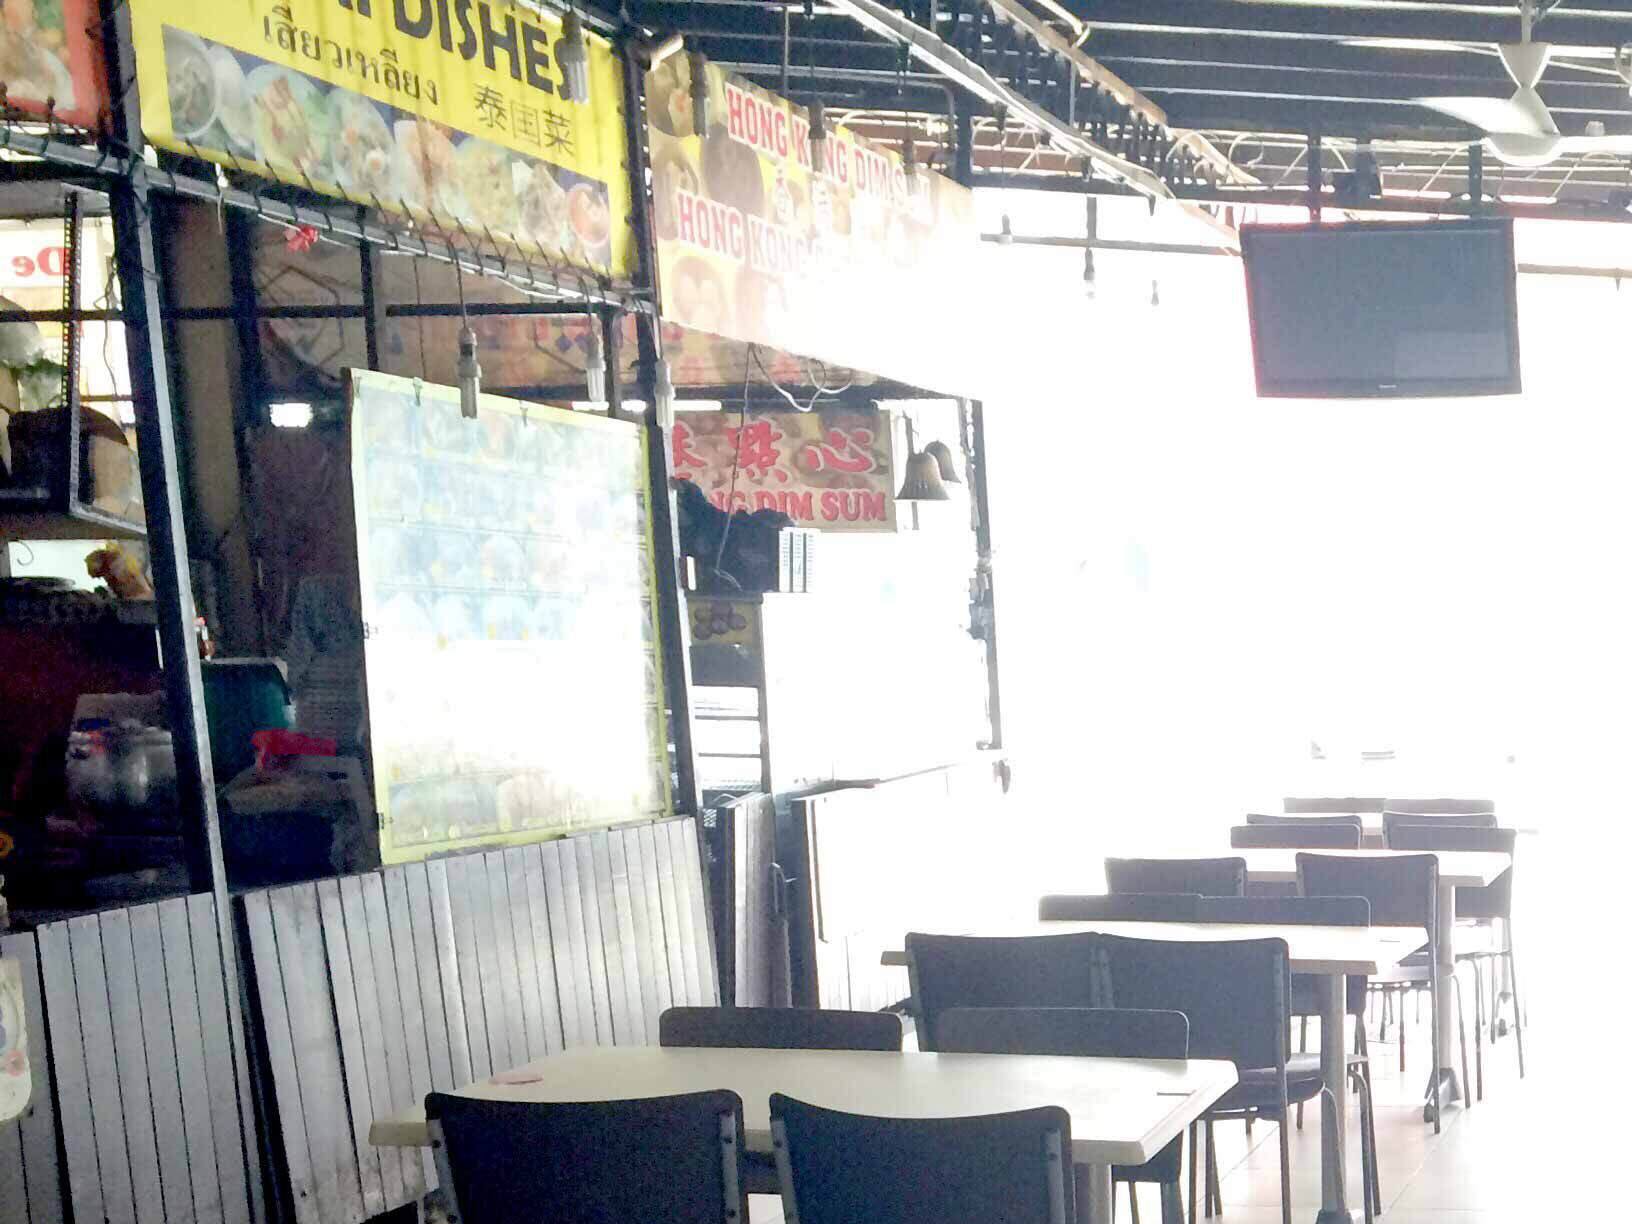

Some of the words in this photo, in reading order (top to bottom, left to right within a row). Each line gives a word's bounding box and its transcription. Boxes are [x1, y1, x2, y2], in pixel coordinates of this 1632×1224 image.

[473, 83, 575, 157] 泰国菜
[727, 87, 788, 157] HONG
[792, 115, 848, 184] KNG
[678, 193, 743, 260] HONG
[753, 490, 815, 521] DIM
[820, 490, 888, 522] SUM
